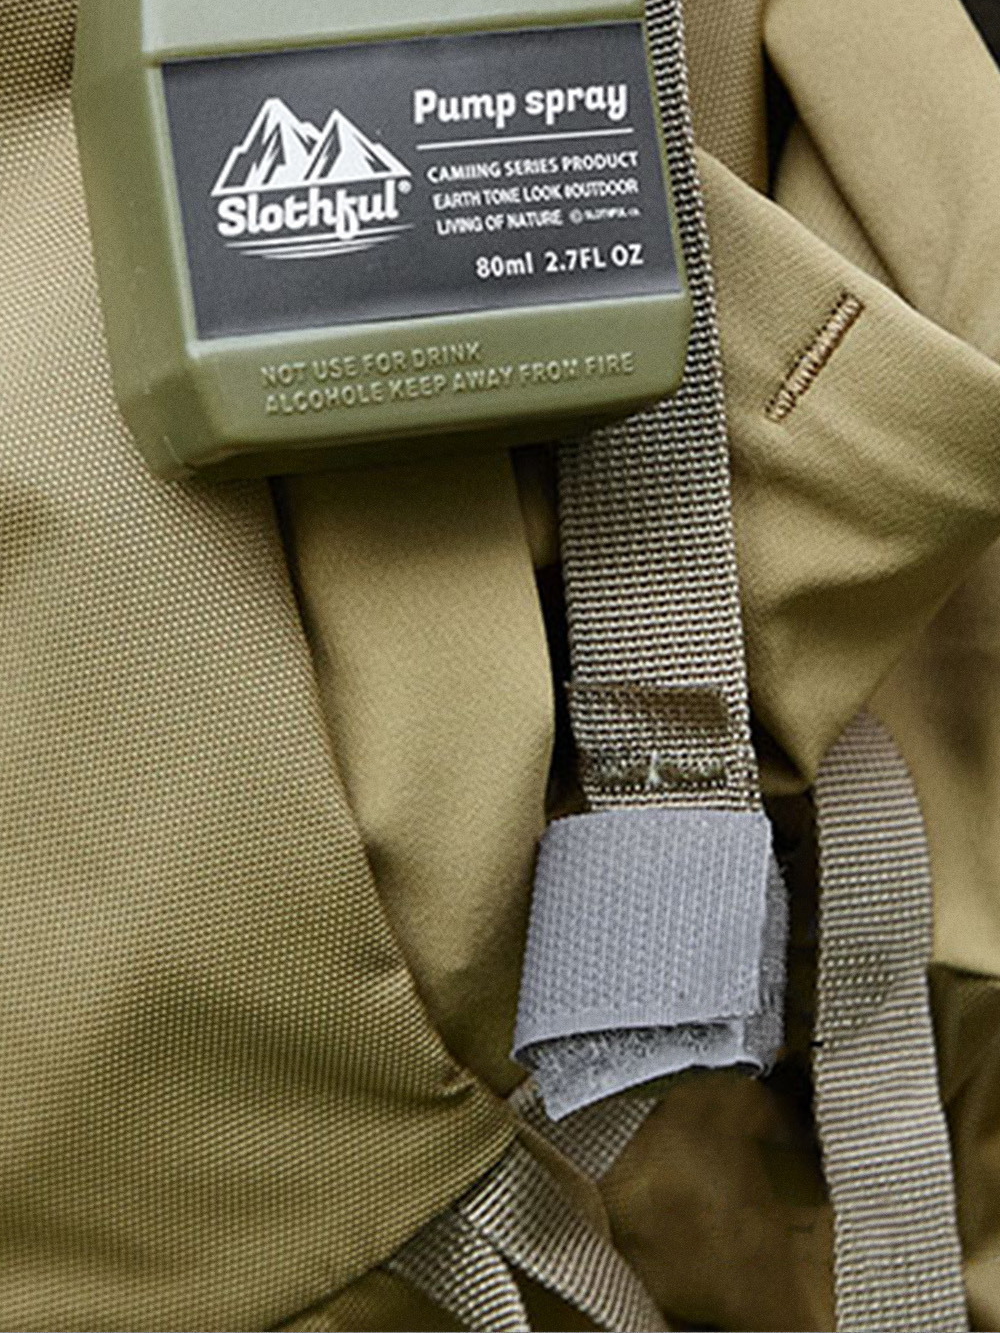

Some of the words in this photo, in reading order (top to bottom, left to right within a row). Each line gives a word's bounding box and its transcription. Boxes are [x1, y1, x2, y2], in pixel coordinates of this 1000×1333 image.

[414, 87, 516, 129] Pump
[525, 82, 628, 123] spray
[503, 157, 558, 176] SERIES
[561, 151, 639, 172] PRODUCT
[216, 179, 399, 241] Slothful
[432, 191, 481, 211] EARTH
[482, 186, 520, 205] TONE
[522, 183, 563, 203] LOOK
[436, 215, 483, 236] LIVING
[485, 213, 504, 231] OF
[506, 209, 564, 229] NATURE
[476, 251, 533, 279] 80ml
[545, 247, 605, 274] 2.7FL
[611, 244, 644, 267] OZ
[261, 362, 306, 386] NOT
[311, 356, 358, 381] USE
[362, 350, 407, 375] FOR
[412, 342, 483, 369] DRINK
[264, 382, 385, 416] ALCOHOLE
[388, 375, 448, 401] KEEP
[452, 366, 513, 393] AWAY
[518, 360, 579, 385] FROM
[584, 352, 635, 377] FIRE
